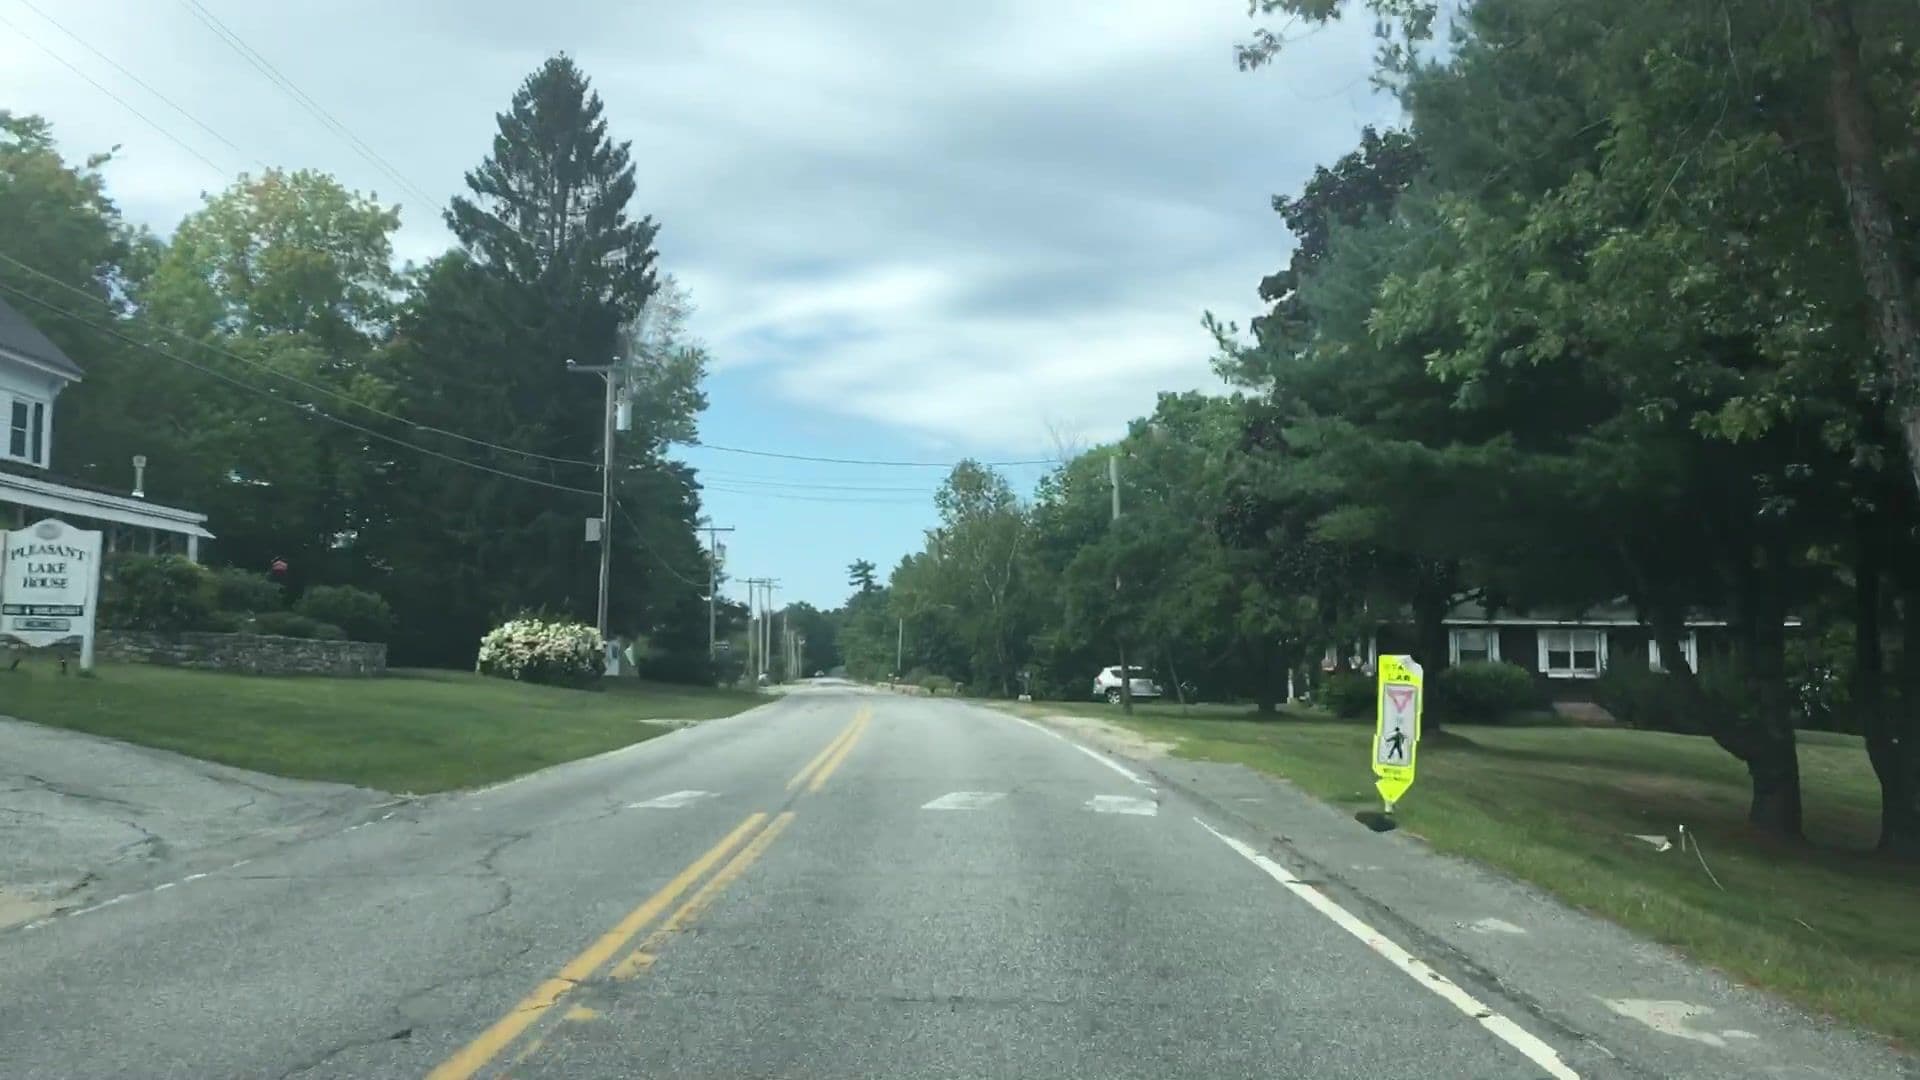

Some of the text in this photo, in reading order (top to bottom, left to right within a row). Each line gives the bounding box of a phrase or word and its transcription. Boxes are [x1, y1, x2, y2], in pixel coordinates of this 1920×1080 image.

[11, 544, 86, 561] PLEASANT
[27, 562, 67, 574] LAKE
[22, 577, 69, 589] HOUSE
